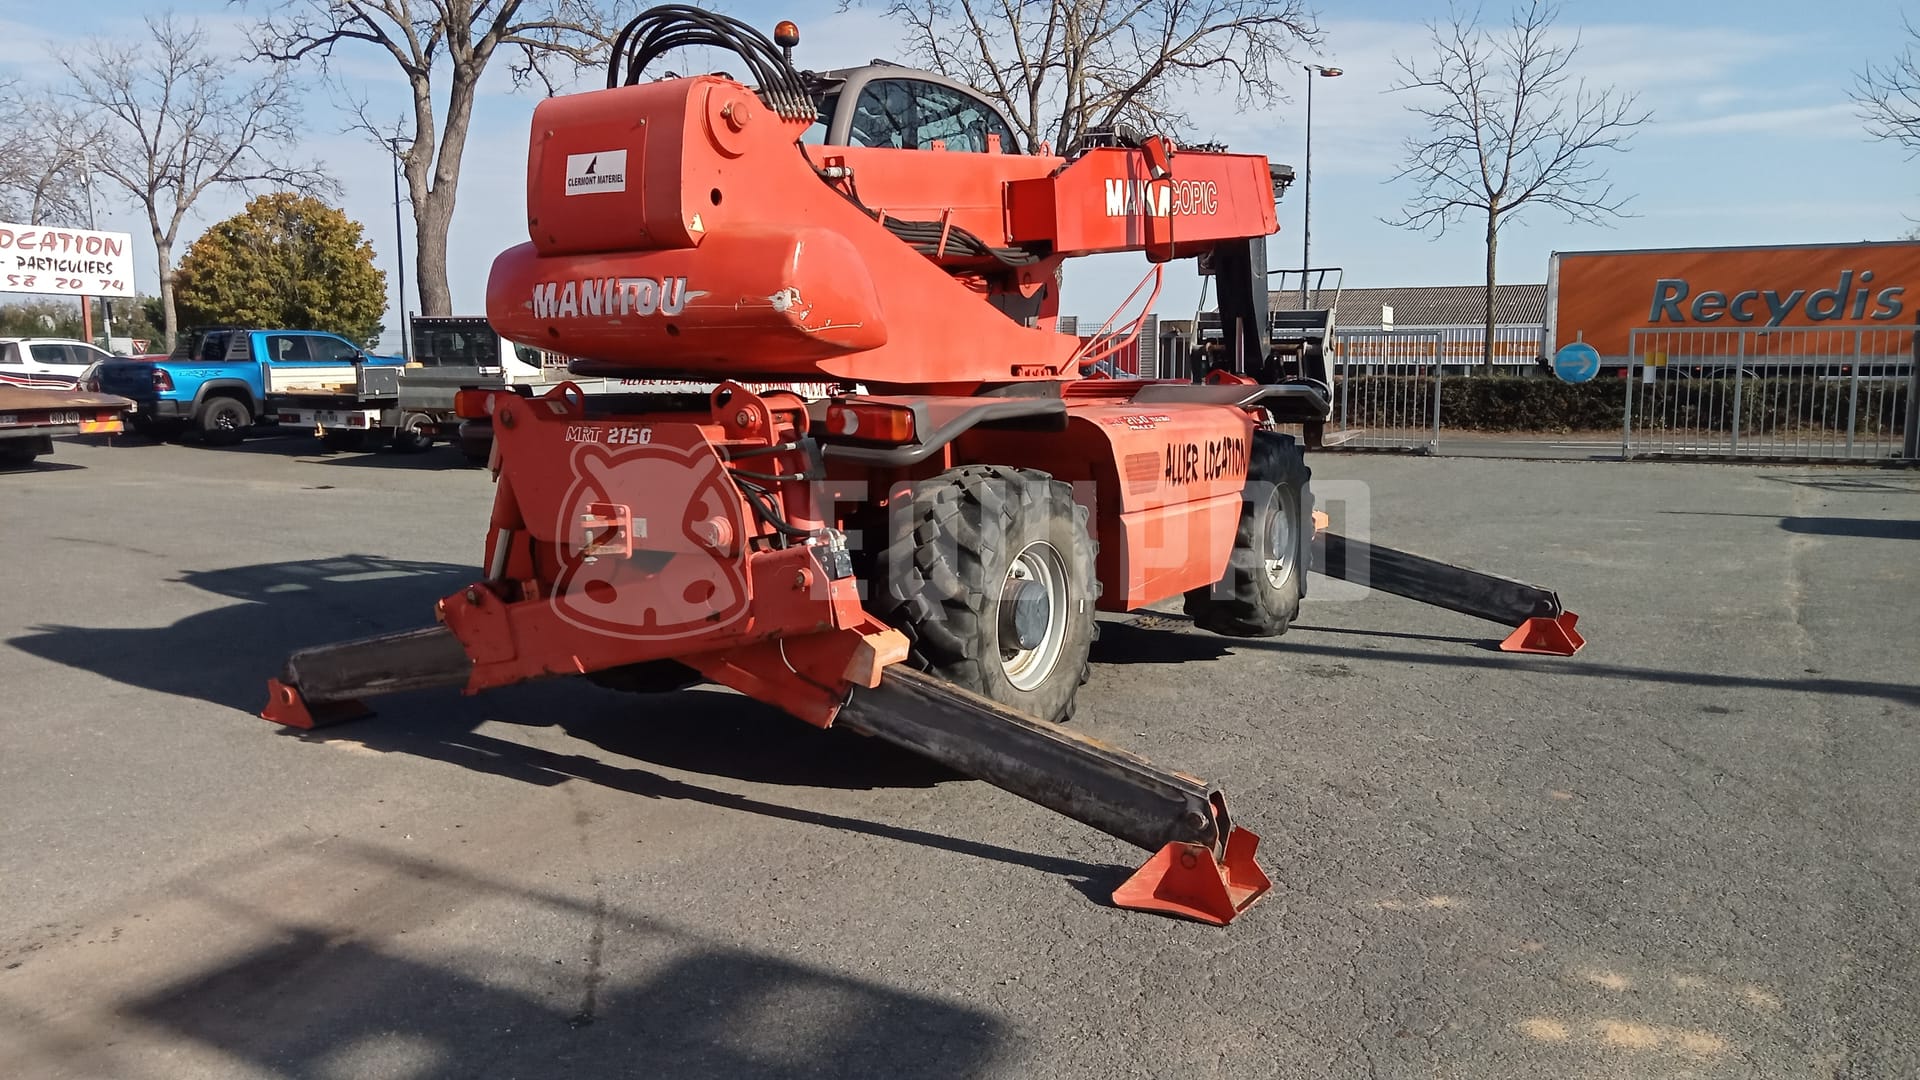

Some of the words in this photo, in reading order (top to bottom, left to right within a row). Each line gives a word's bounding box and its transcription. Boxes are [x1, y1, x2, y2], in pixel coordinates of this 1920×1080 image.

[567, 176, 597, 187] CLERMONT
[597, 173, 624, 184] MATERIEL
[16, 255, 113, 275] PARTICULIERS
[6, 274, 37, 287] 58
[55, 277, 83, 289] 20
[99, 279, 124, 291] 74
[533, 277, 688, 319] MANITOU
[1648, 269, 1905, 336] Recydis
[565, 425, 603, 443] MRT
[607, 427, 652, 444] 2150
[1165, 443, 1198, 488] ALLIER
[1204, 436, 1246, 482] LOCATION
